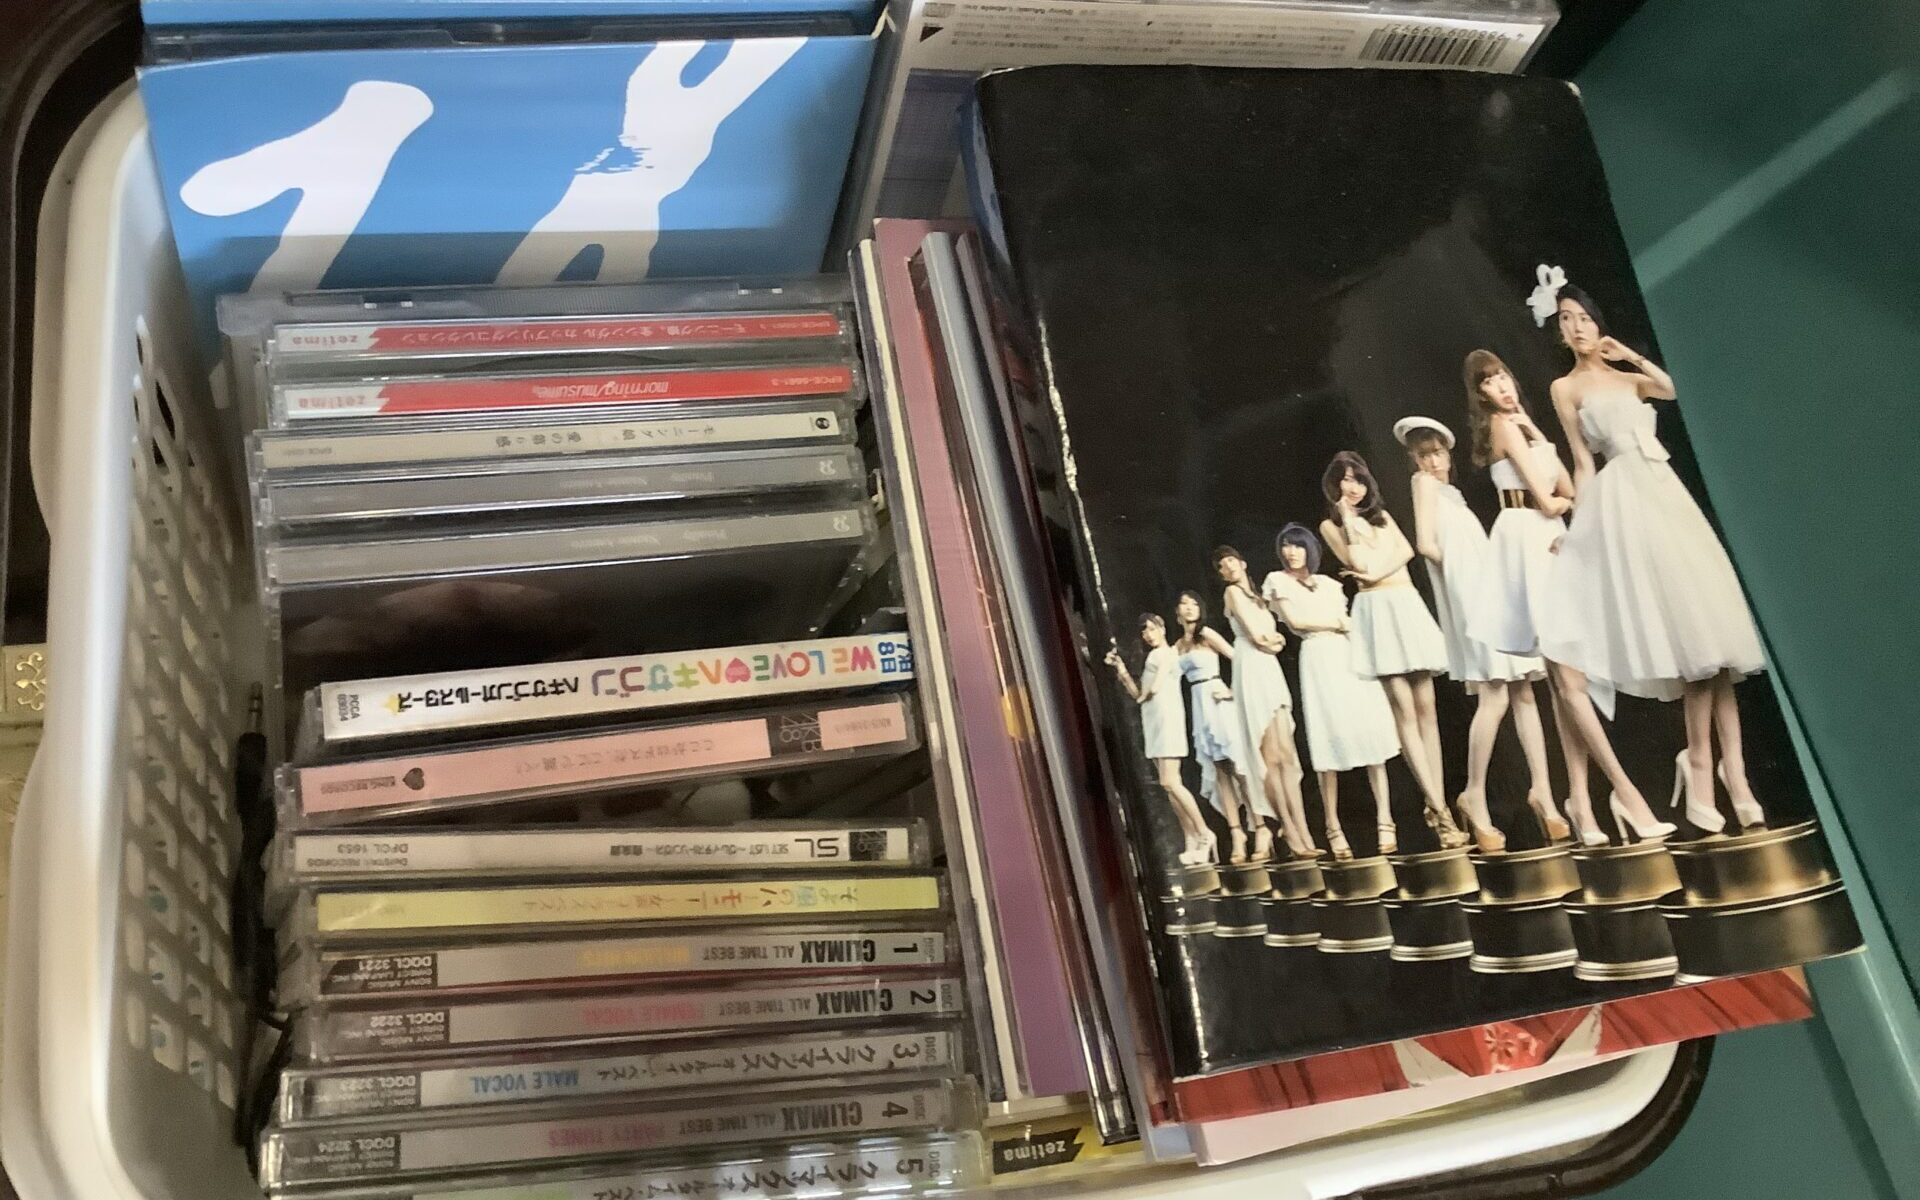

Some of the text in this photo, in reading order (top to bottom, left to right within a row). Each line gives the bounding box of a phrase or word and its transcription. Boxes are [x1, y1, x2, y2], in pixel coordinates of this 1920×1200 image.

[292, 333, 358, 348] zetima
[298, 394, 366, 410] zetima
[751, 653, 826, 682] LOVE
[830, 645, 876, 674] WE
[397, 676, 579, 713] ヘキサゴンオールスターズ
[702, 946, 737, 962] BEST
[737, 946, 769, 961] TIME
[772, 945, 795, 959] ALL
[799, 939, 877, 964] CLIMAX
[893, 942, 919, 954] 1
[357, 958, 392, 972] 3221
[718, 988, 894, 1017] CLIMAX ALL TIME BEST
[910, 988, 937, 1006] 2
[891, 1042, 920, 1060] 3
[471, 1069, 579, 1094] MALE VOCAL
[780, 1101, 864, 1132] CLIMAX
[881, 1101, 909, 1119] 4
[678, 1118, 714, 1136] BEST
[1002, 1139, 1067, 1163] zetima
[895, 1158, 924, 1176] 5
